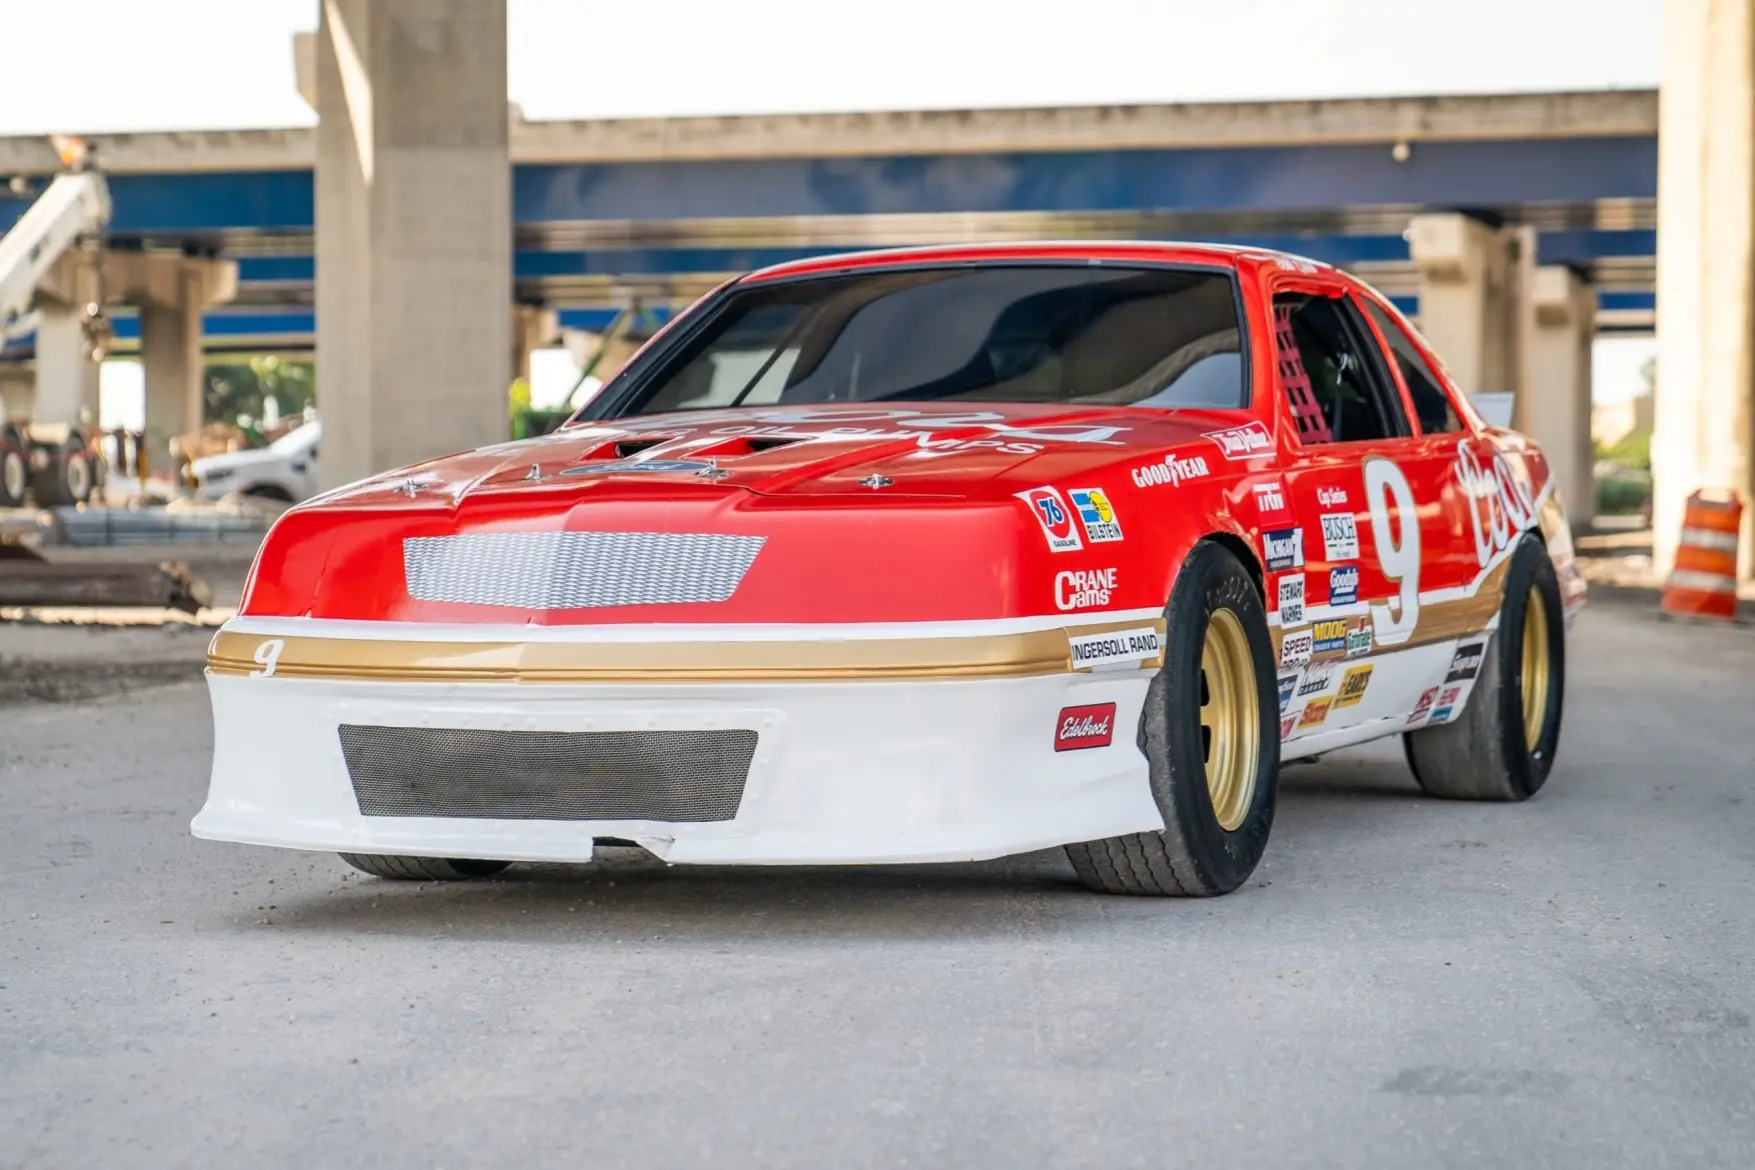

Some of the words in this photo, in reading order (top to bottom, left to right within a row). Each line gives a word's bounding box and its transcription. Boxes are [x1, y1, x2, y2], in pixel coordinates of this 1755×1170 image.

[709, 426, 794, 435] OIL
[1131, 454, 1210, 487] GOODYEAR
[1038, 498, 1063, 526] 76
[1086, 523, 1122, 540] BILSTEIN
[1322, 516, 1356, 540] BUSCH
[1053, 539, 1077, 548] GASOLINE
[1363, 455, 1421, 646] 9
[1055, 568, 1118, 610] CRANE
[1055, 571, 1112, 610] Cams
[1314, 620, 1347, 641] MOOG
[249, 639, 284, 678] 9
[1071, 638, 1129, 661] INGERSOLL
[1129, 634, 1158, 652] RAND
[1283, 636, 1312, 657] SPEED
